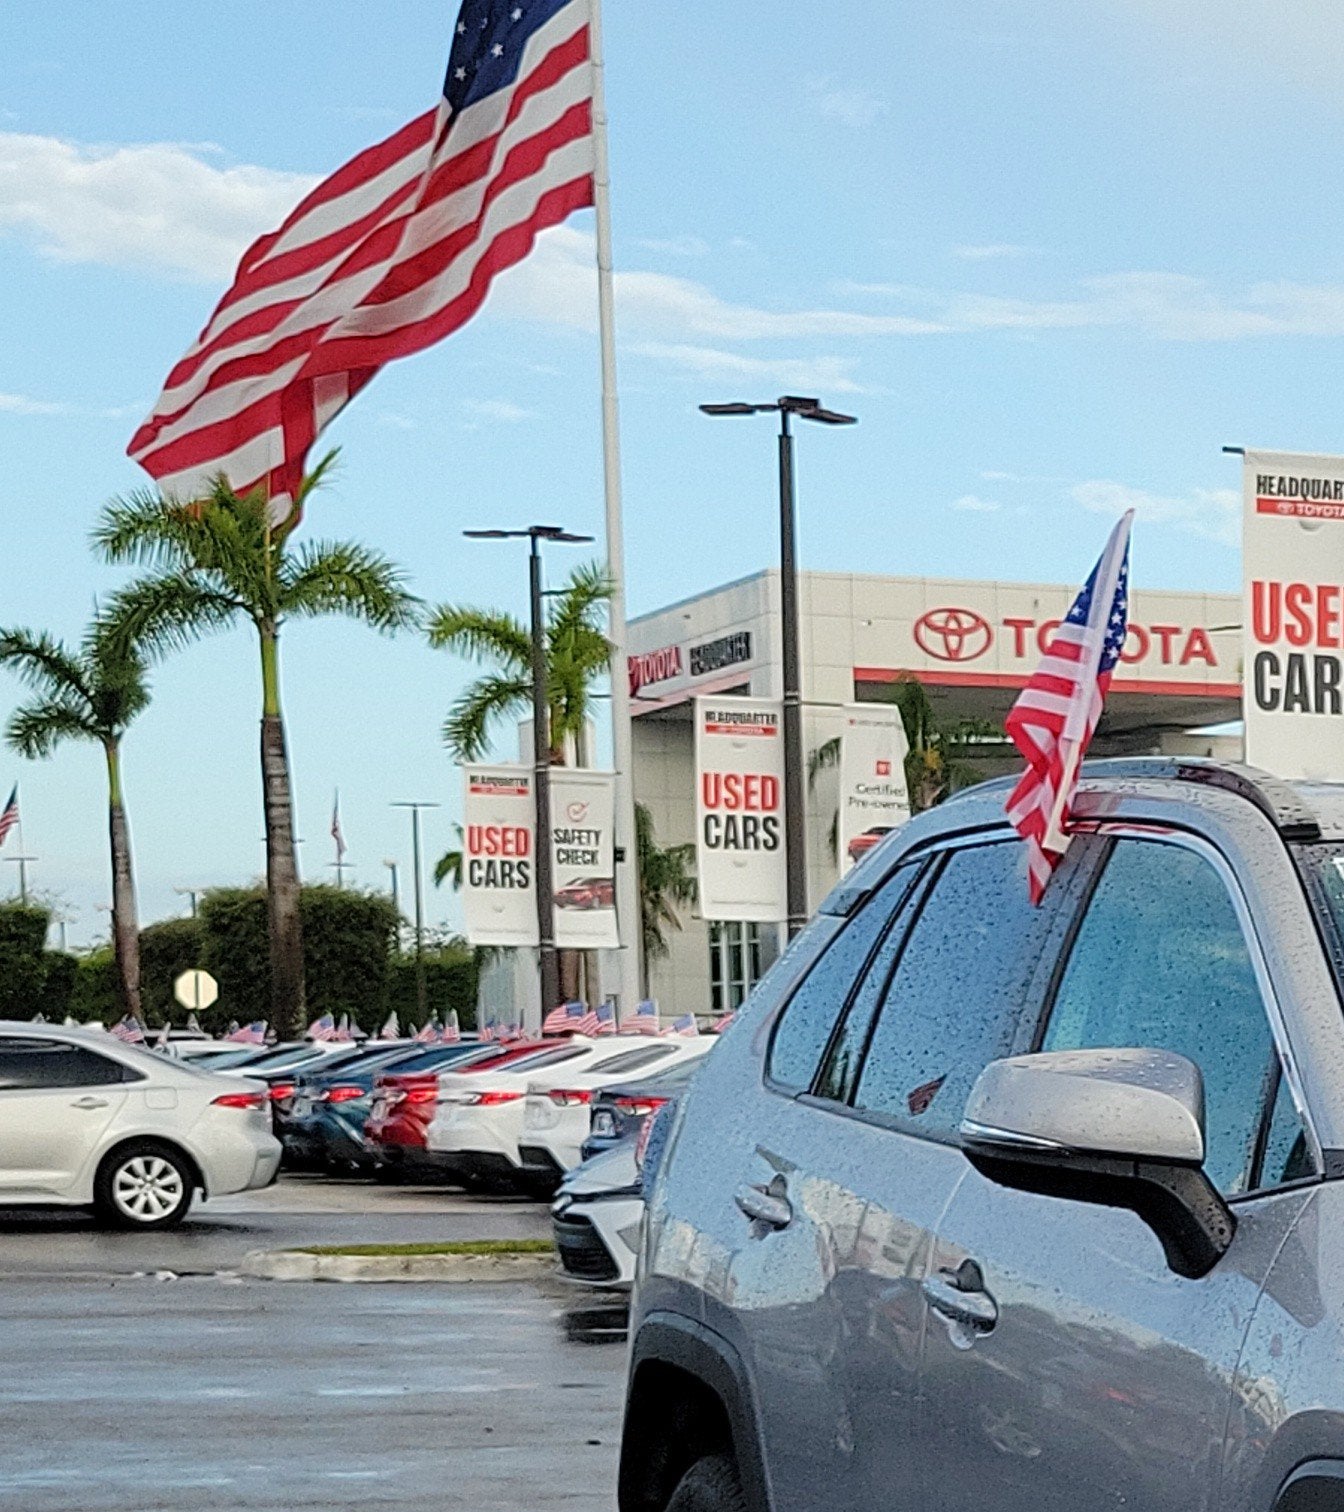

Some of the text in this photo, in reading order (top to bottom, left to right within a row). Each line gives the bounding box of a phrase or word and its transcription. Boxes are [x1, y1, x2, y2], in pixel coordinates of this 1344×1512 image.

[1002, 618, 1219, 666] TOTA
[702, 772, 779, 812] USED
[467, 825, 530, 857] USED
[553, 828, 602, 846] SAFETY
[703, 813, 780, 850] CARS
[556, 848, 599, 866] CHECK
[468, 858, 530, 889] CARS
